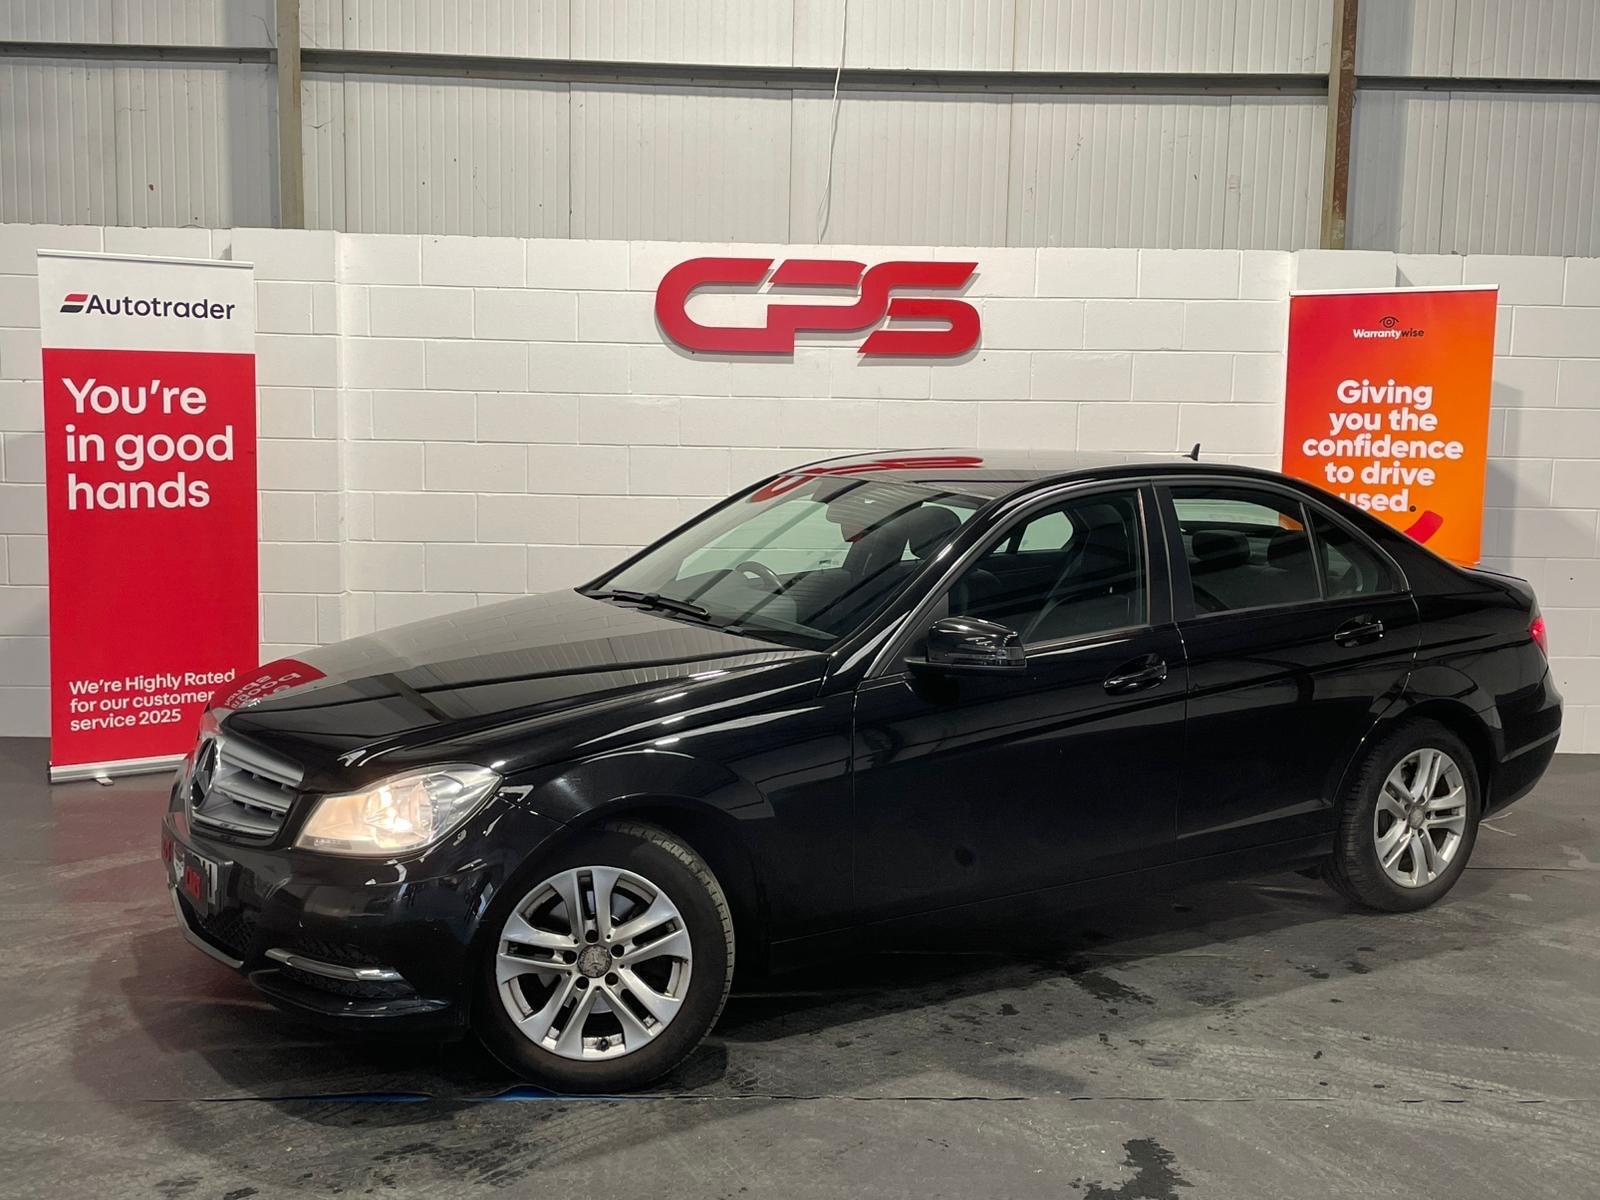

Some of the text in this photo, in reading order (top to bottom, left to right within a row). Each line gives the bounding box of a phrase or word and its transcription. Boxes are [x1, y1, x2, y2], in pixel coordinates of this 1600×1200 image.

[85, 294, 235, 319] Autotrader
[655, 257, 980, 357] CPS
[1353, 328, 1424, 340] Warrantywise
[61, 378, 207, 415] You’re
[1336, 379, 1433, 410] Giving
[1329, 407, 1438, 436] you the
[65, 424, 234, 471] in good
[1302, 433, 1464, 460] confidence
[1324, 460, 1436, 486] to drive
[68, 472, 210, 510] hands
[69, 668, 235, 695] We’re Highly Rated
[70, 690, 215, 714] for our customer
[70, 708, 181, 731] service 2025
